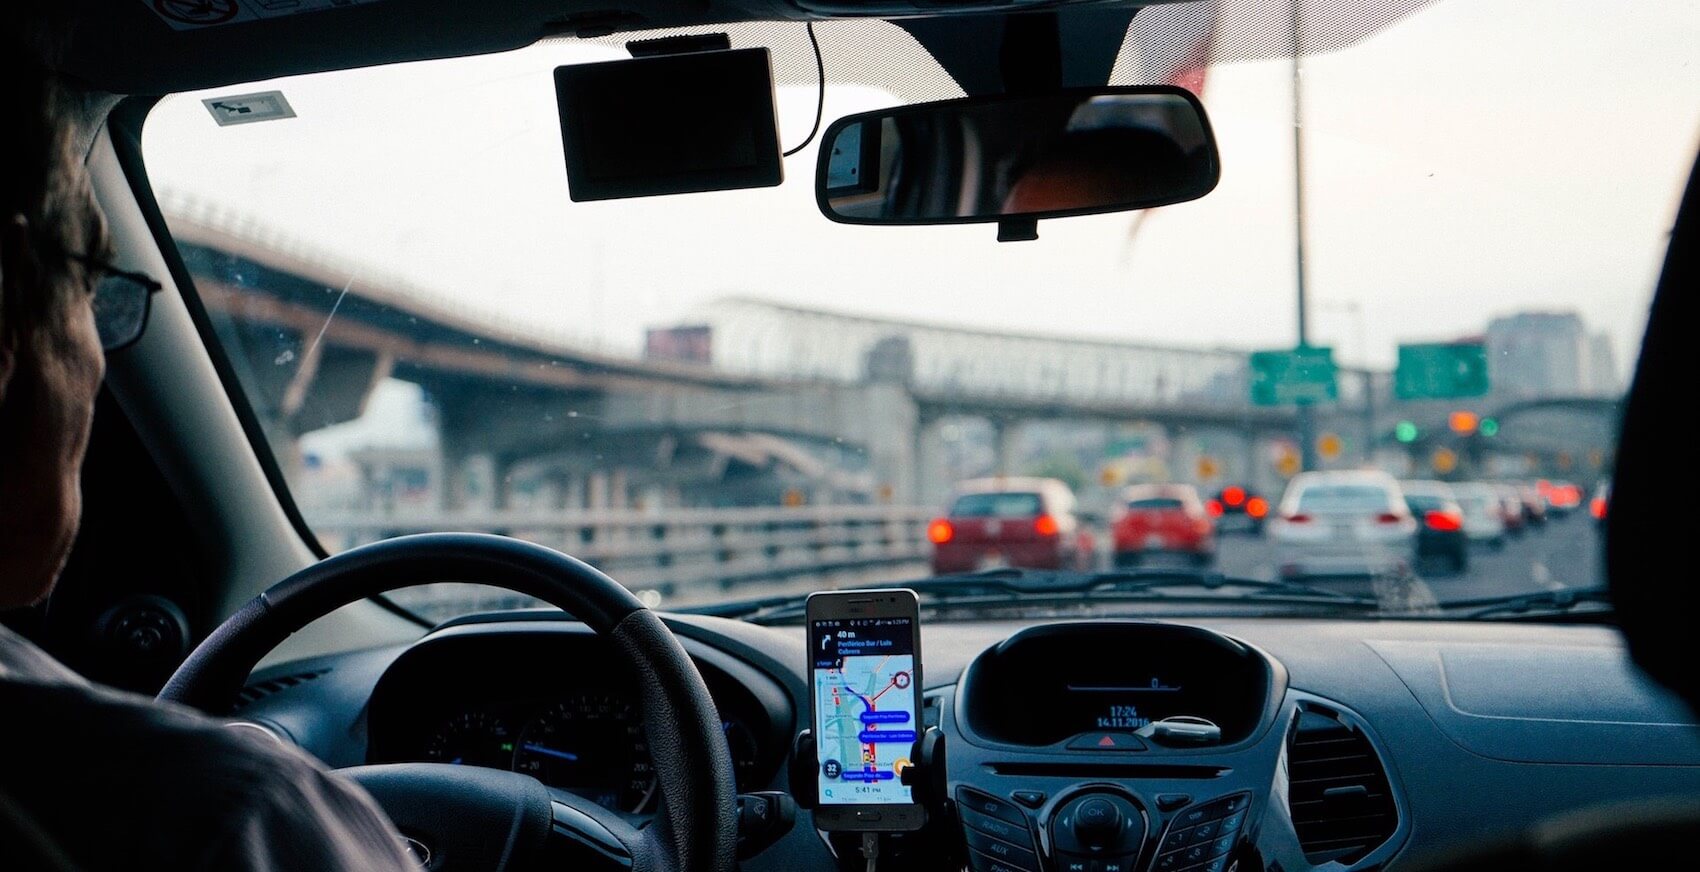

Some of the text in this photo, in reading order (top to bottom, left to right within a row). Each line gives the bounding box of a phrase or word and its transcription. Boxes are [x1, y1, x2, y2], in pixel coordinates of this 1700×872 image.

[837, 630, 847, 638] 40
[1110, 705, 1138, 717] 17:24
[1097, 717, 1150, 728] 14.11.2016
[827, 763, 837, 772] 32
[984, 802, 998, 812] CD
[1087, 808, 1105, 817] OK
[982, 821, 1009, 835] RADIO
[1202, 825, 1210, 834] 2
[990, 843, 1009, 856] AUX
